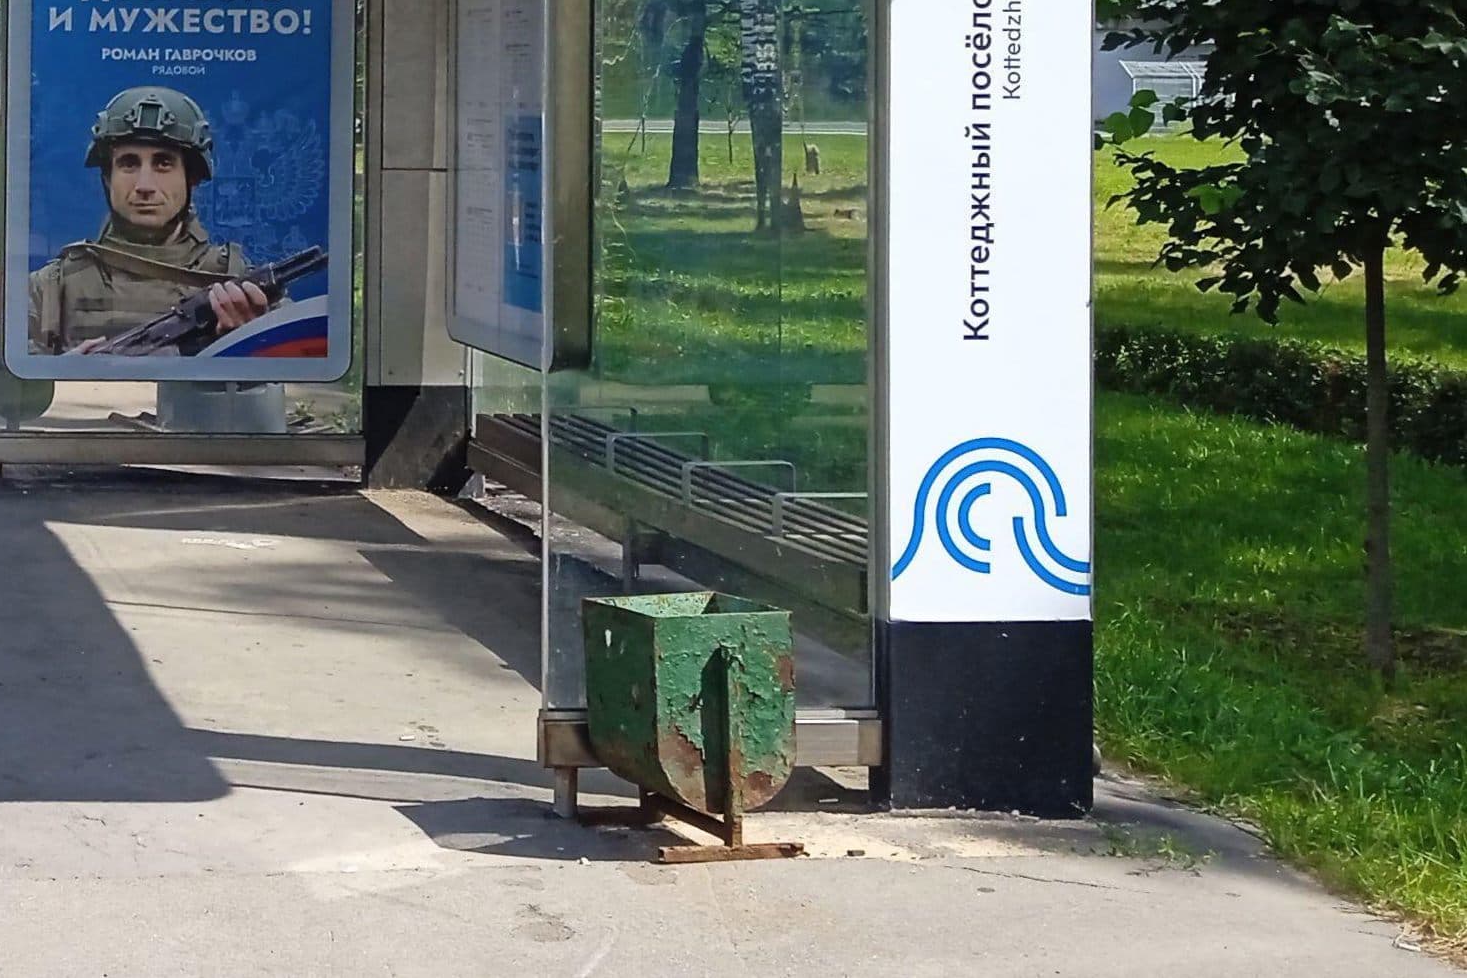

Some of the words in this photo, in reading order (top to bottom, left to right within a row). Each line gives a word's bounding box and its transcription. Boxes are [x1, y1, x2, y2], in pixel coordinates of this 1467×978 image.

[48, 6, 73, 32] И
[88, 7, 312, 35] МУЖЕСТВО!
[101, 48, 160, 61] РОМАН
[164, 48, 257, 61] ГАВРОЧКОВ
[151, 63, 206, 75] РЯДОВОЙ
[963, 123, 994, 340] Коттеджный
